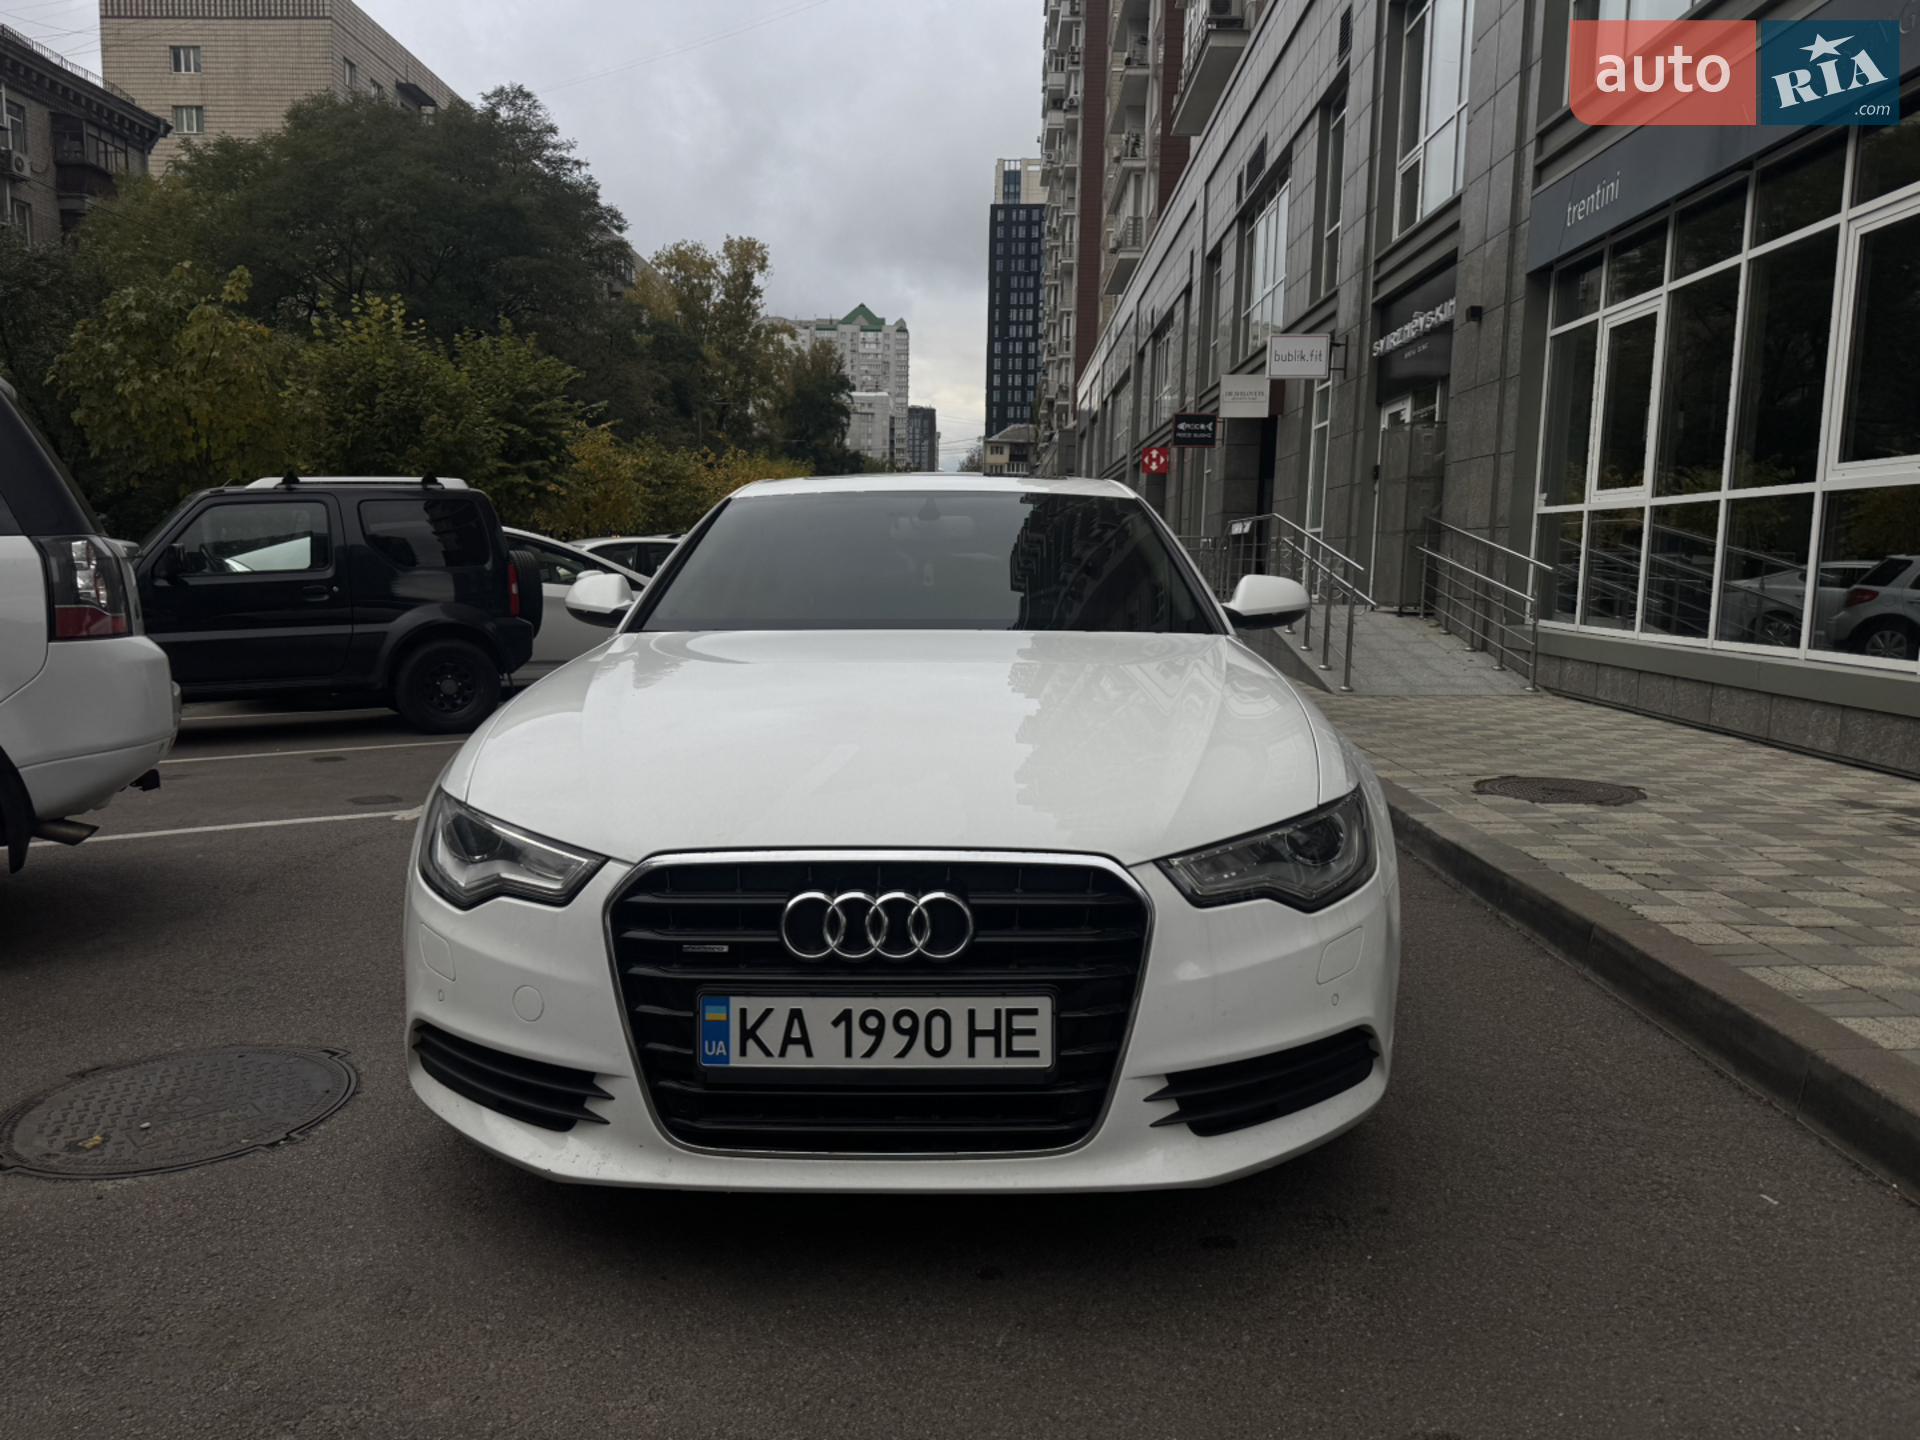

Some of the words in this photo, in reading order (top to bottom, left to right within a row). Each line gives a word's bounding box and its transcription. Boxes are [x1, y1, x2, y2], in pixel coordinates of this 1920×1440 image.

[1567, 170, 1620, 227] trentini
[1274, 349, 1322, 362] bublik.fit
[705, 1041, 727, 1056] UA
[739, 1008, 814, 1058] KA
[830, 1008, 952, 1058] 1990
[967, 1008, 1040, 1058] HE
